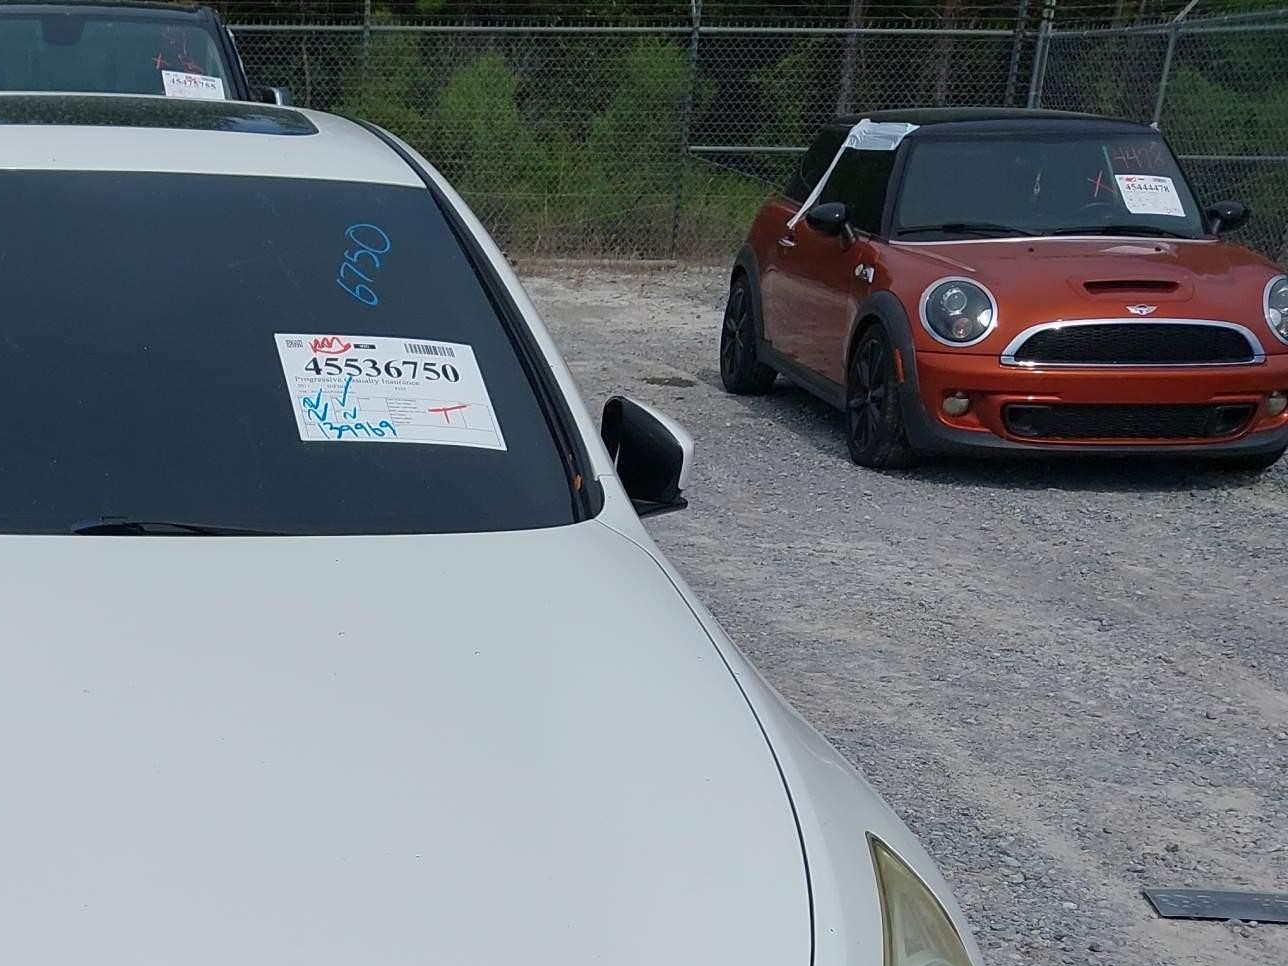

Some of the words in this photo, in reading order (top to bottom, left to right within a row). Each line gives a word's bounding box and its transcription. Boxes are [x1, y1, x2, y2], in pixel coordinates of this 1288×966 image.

[336, 223, 391, 306] 6750
[294, 375, 342, 383] Progressive
[381, 378, 421, 386] Insurance
[304, 356, 460, 383] 45536750
